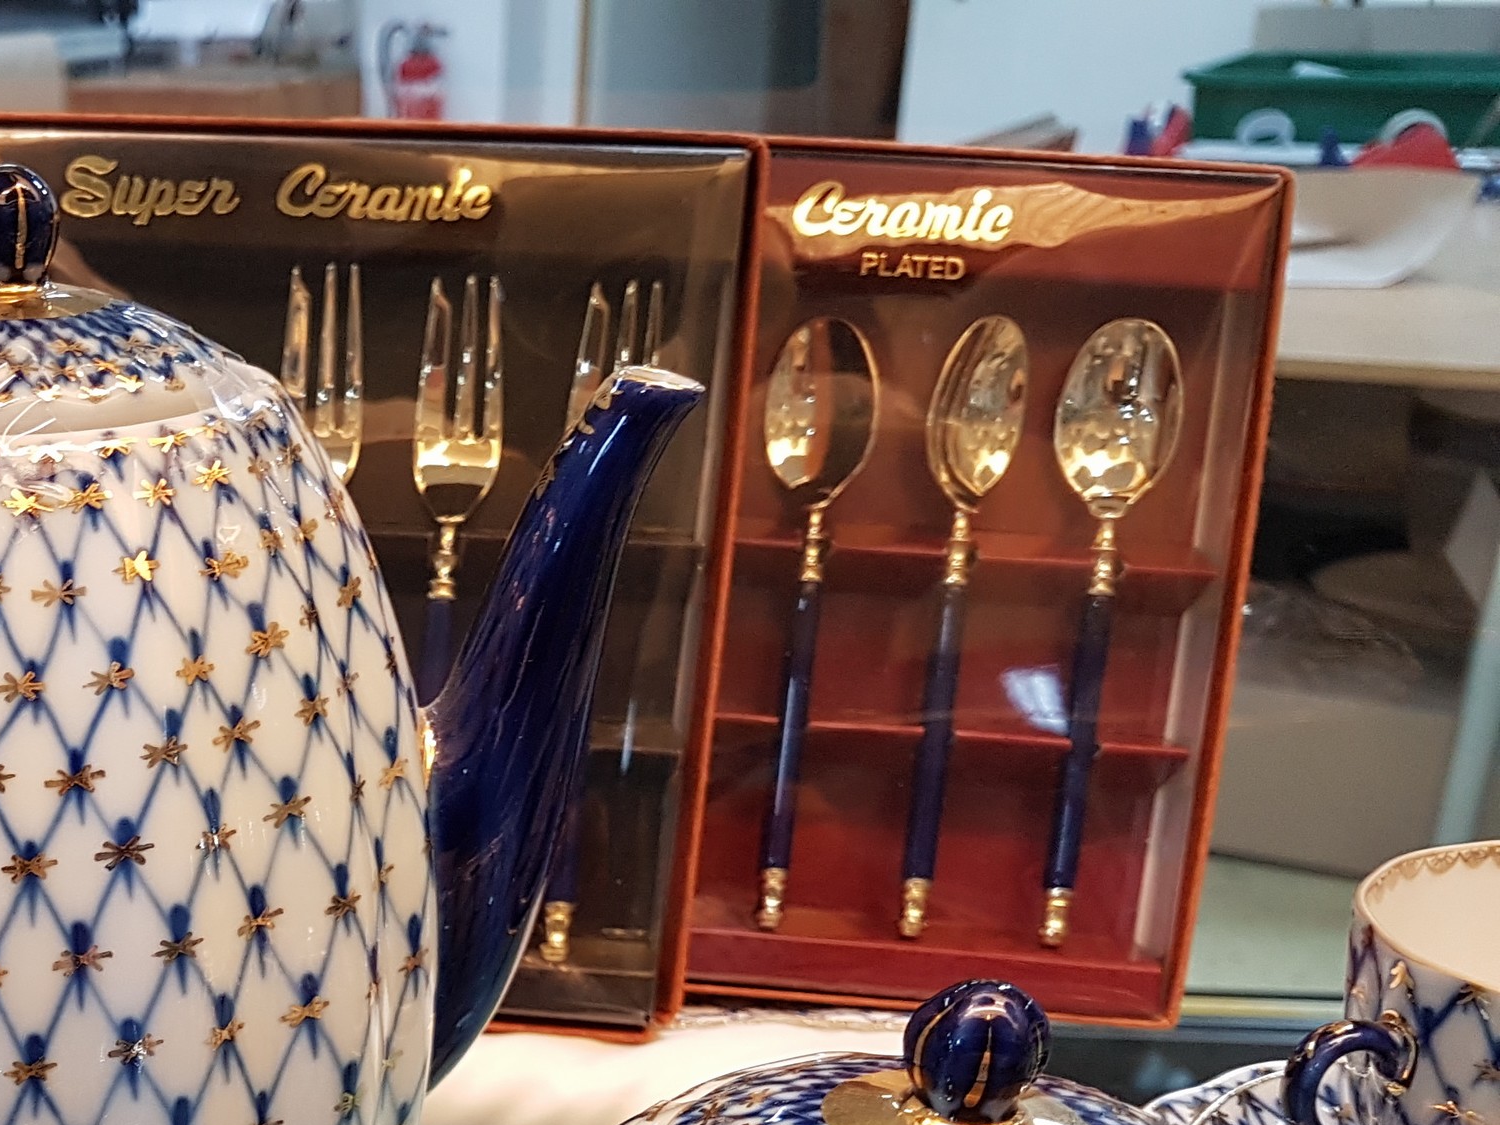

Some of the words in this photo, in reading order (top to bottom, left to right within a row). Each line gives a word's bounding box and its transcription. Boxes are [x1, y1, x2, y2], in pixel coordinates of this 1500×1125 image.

[62, 155, 239, 226] Super
[277, 163, 493, 222] Ceramic
[792, 180, 1014, 242] Ceramic
[860, 252, 966, 281] PLATED
